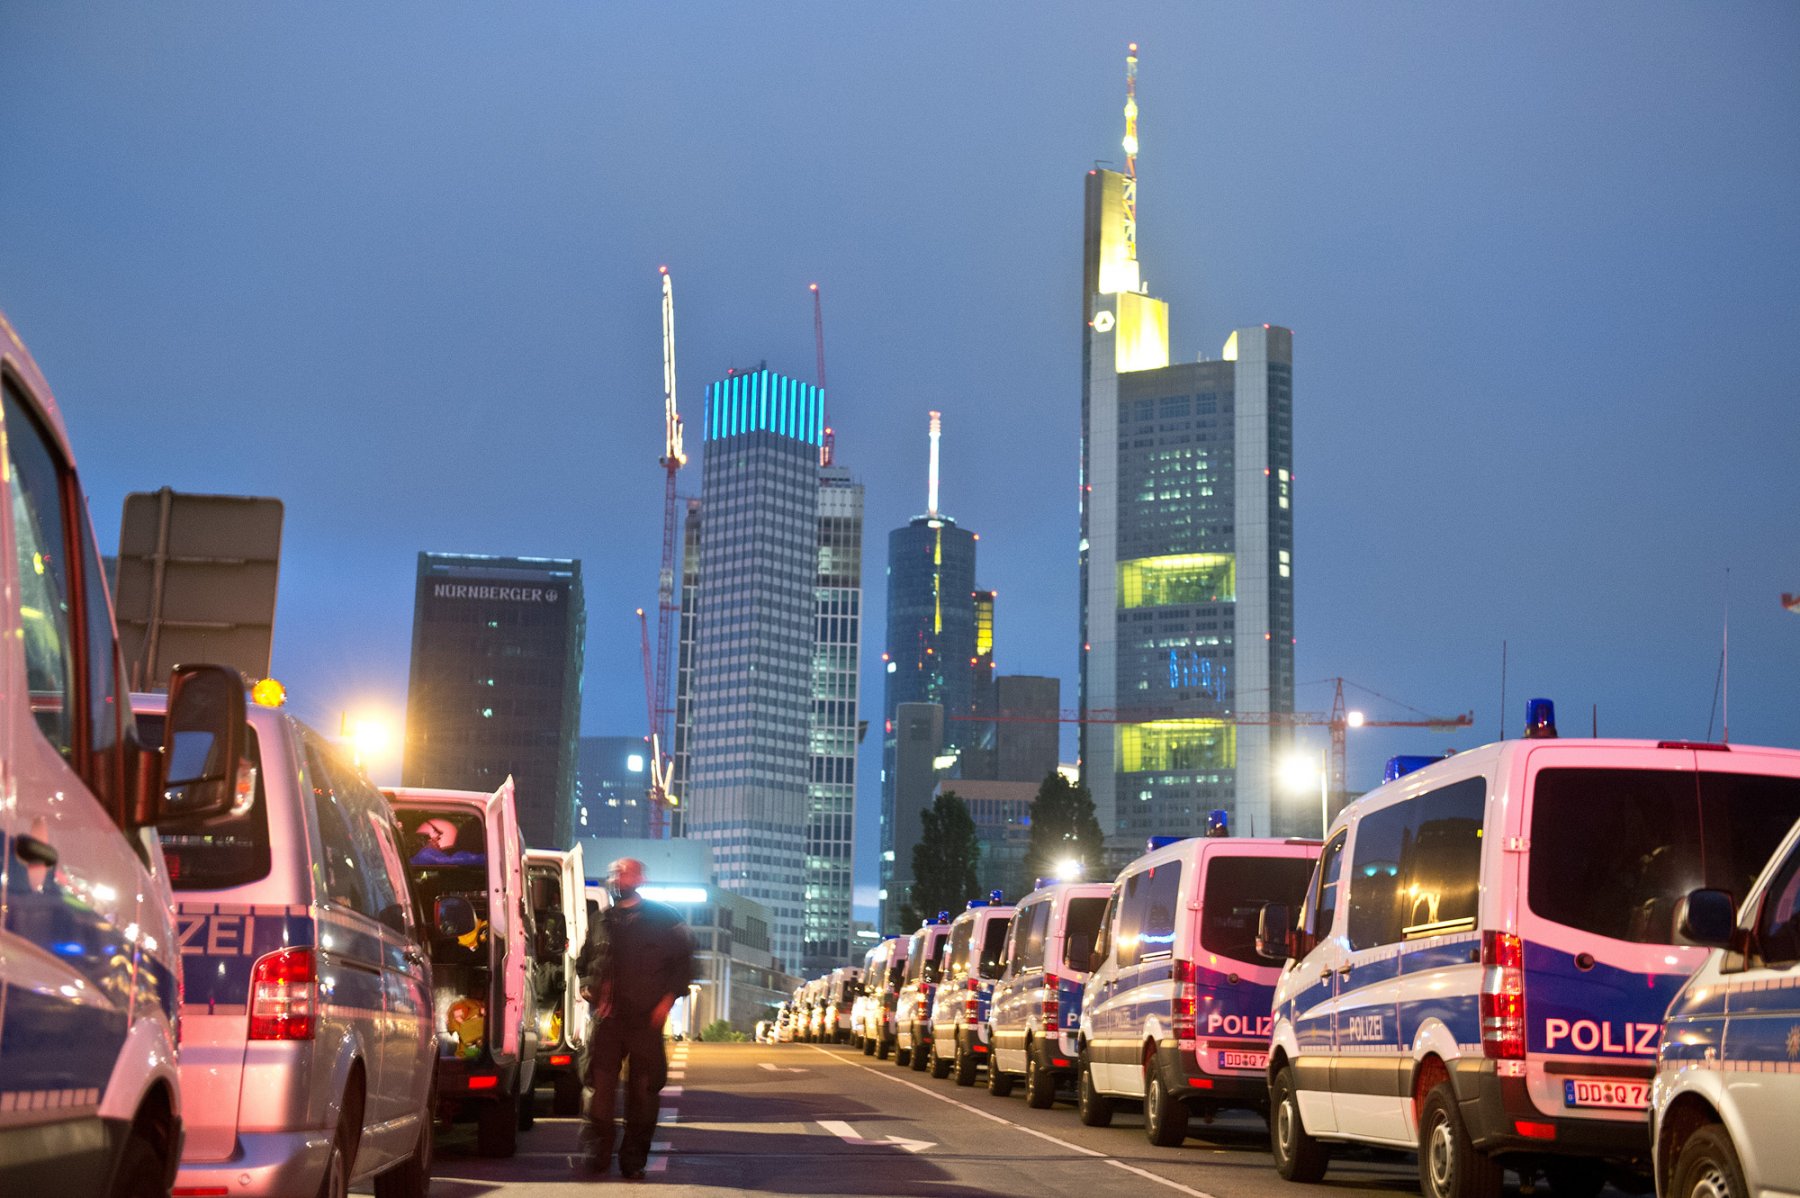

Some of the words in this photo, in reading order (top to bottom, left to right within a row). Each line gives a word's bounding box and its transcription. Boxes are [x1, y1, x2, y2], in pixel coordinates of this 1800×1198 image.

[1349, 1015, 1383, 1041] POLIZEI
[1545, 1018, 1664, 1054] POLIZ
[1577, 1084, 1602, 1102] DD
[1614, 1086, 1627, 1103] Q
